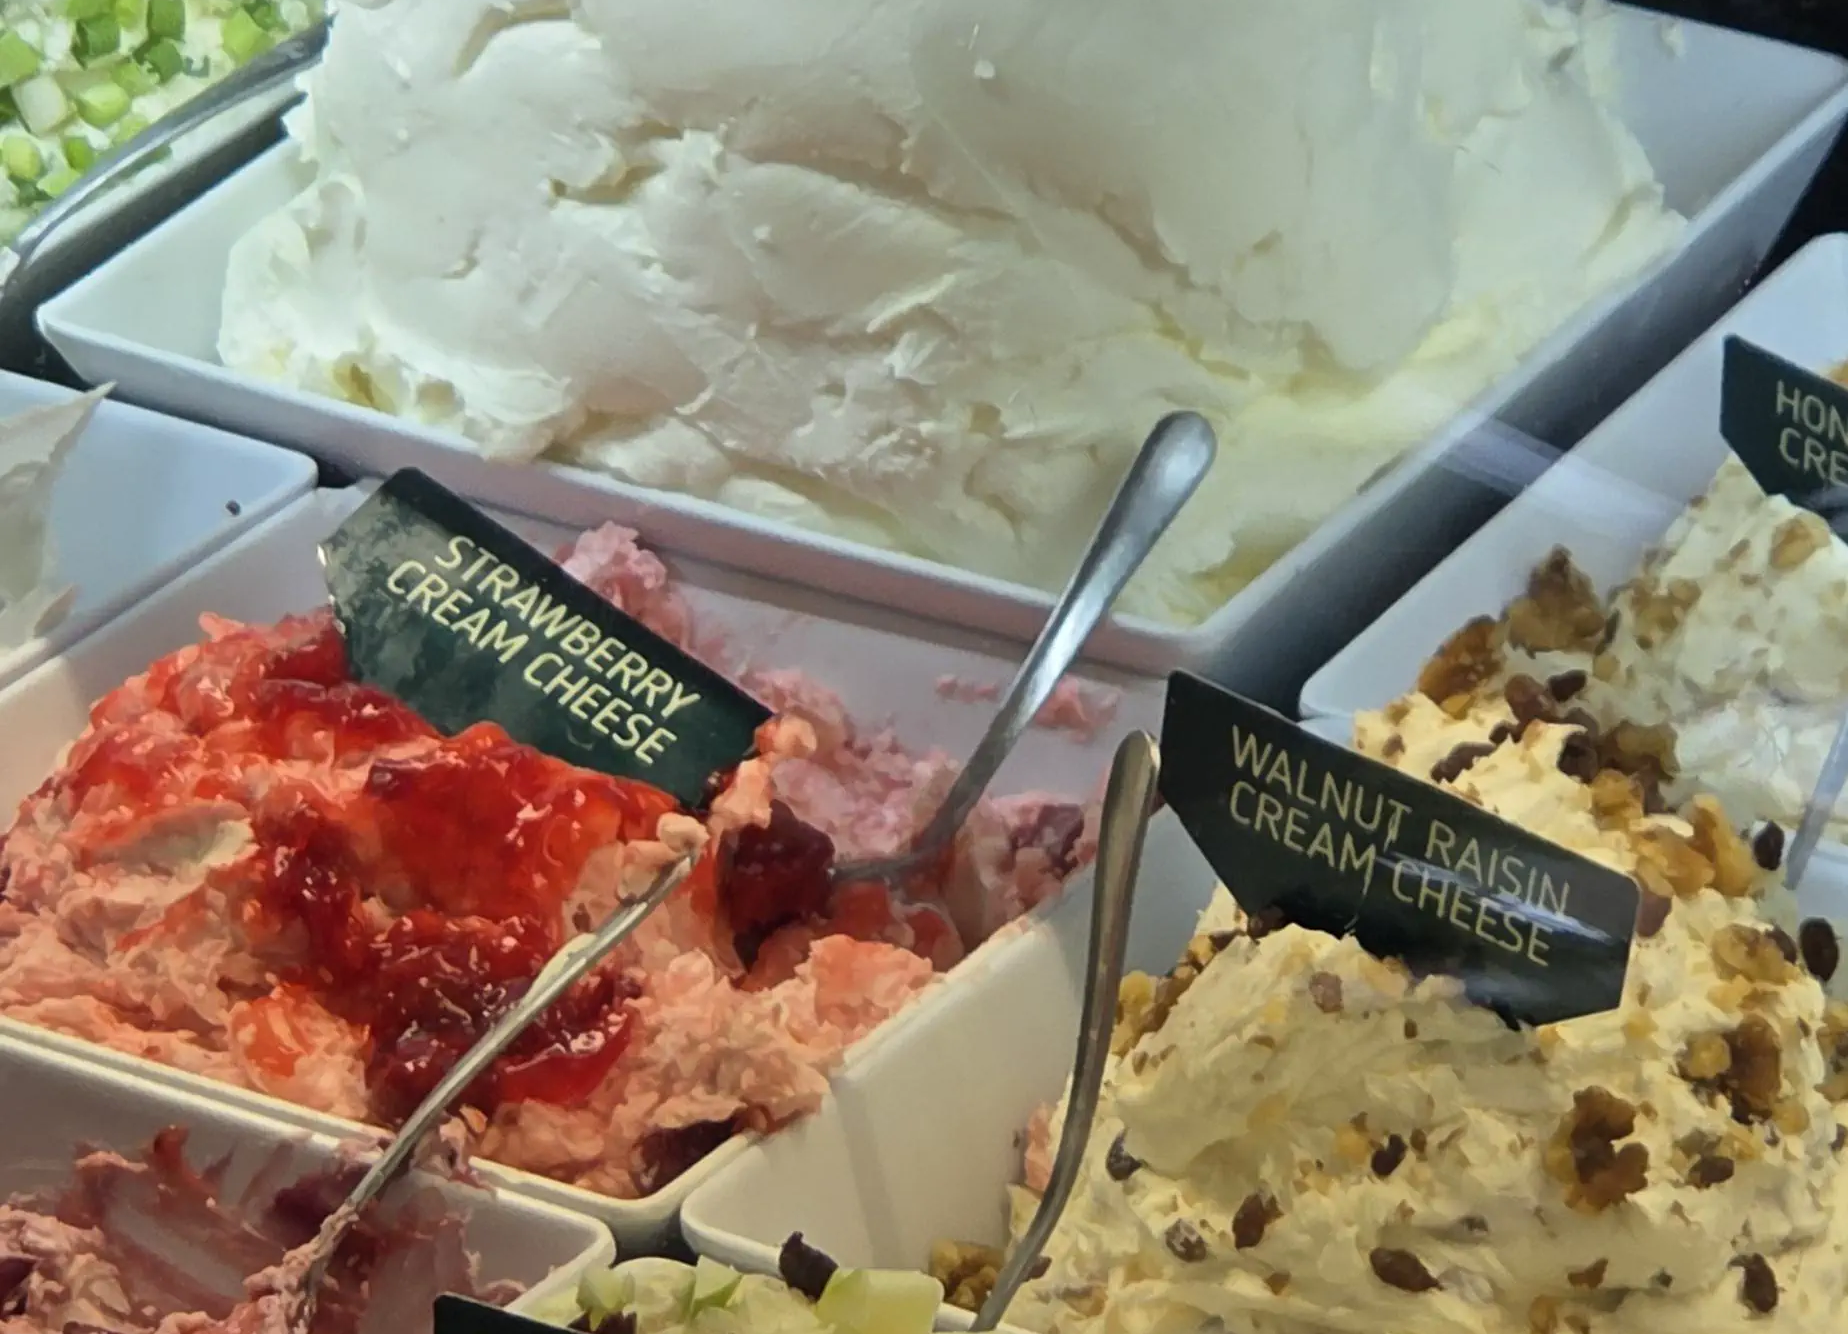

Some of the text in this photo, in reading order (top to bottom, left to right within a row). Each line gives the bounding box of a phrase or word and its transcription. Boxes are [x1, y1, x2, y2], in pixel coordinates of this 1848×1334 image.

[386, 559, 678, 765] CREAM CHEESE
[433, 534, 702, 719] STRAWBERRY
[1229, 781, 1555, 967] CREAM CHEESE
[1231, 724, 1572, 918] WALNUT RAISIN
